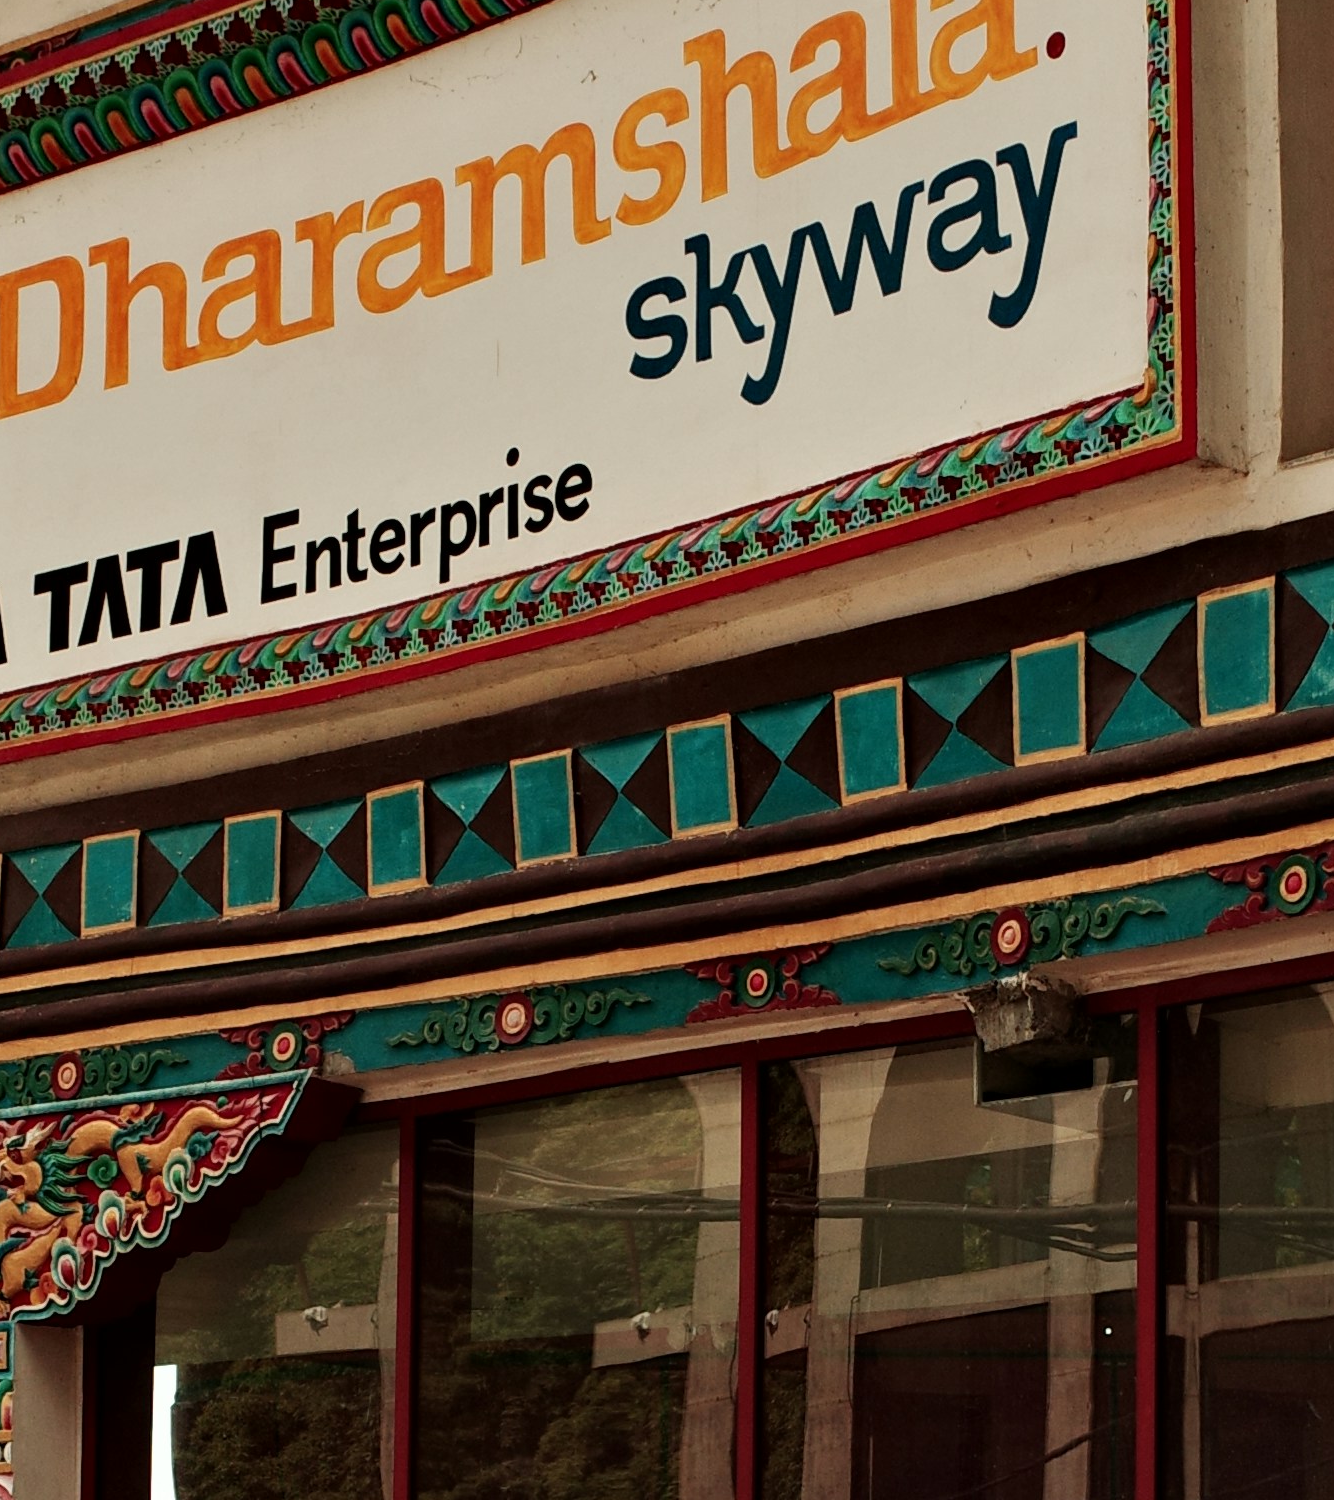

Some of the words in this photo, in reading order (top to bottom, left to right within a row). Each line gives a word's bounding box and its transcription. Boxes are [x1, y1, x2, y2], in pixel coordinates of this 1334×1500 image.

[625, 121, 1078, 406] skyway
[33, 530, 228, 653] TATA
[259, 446, 593, 605] Enterprise
